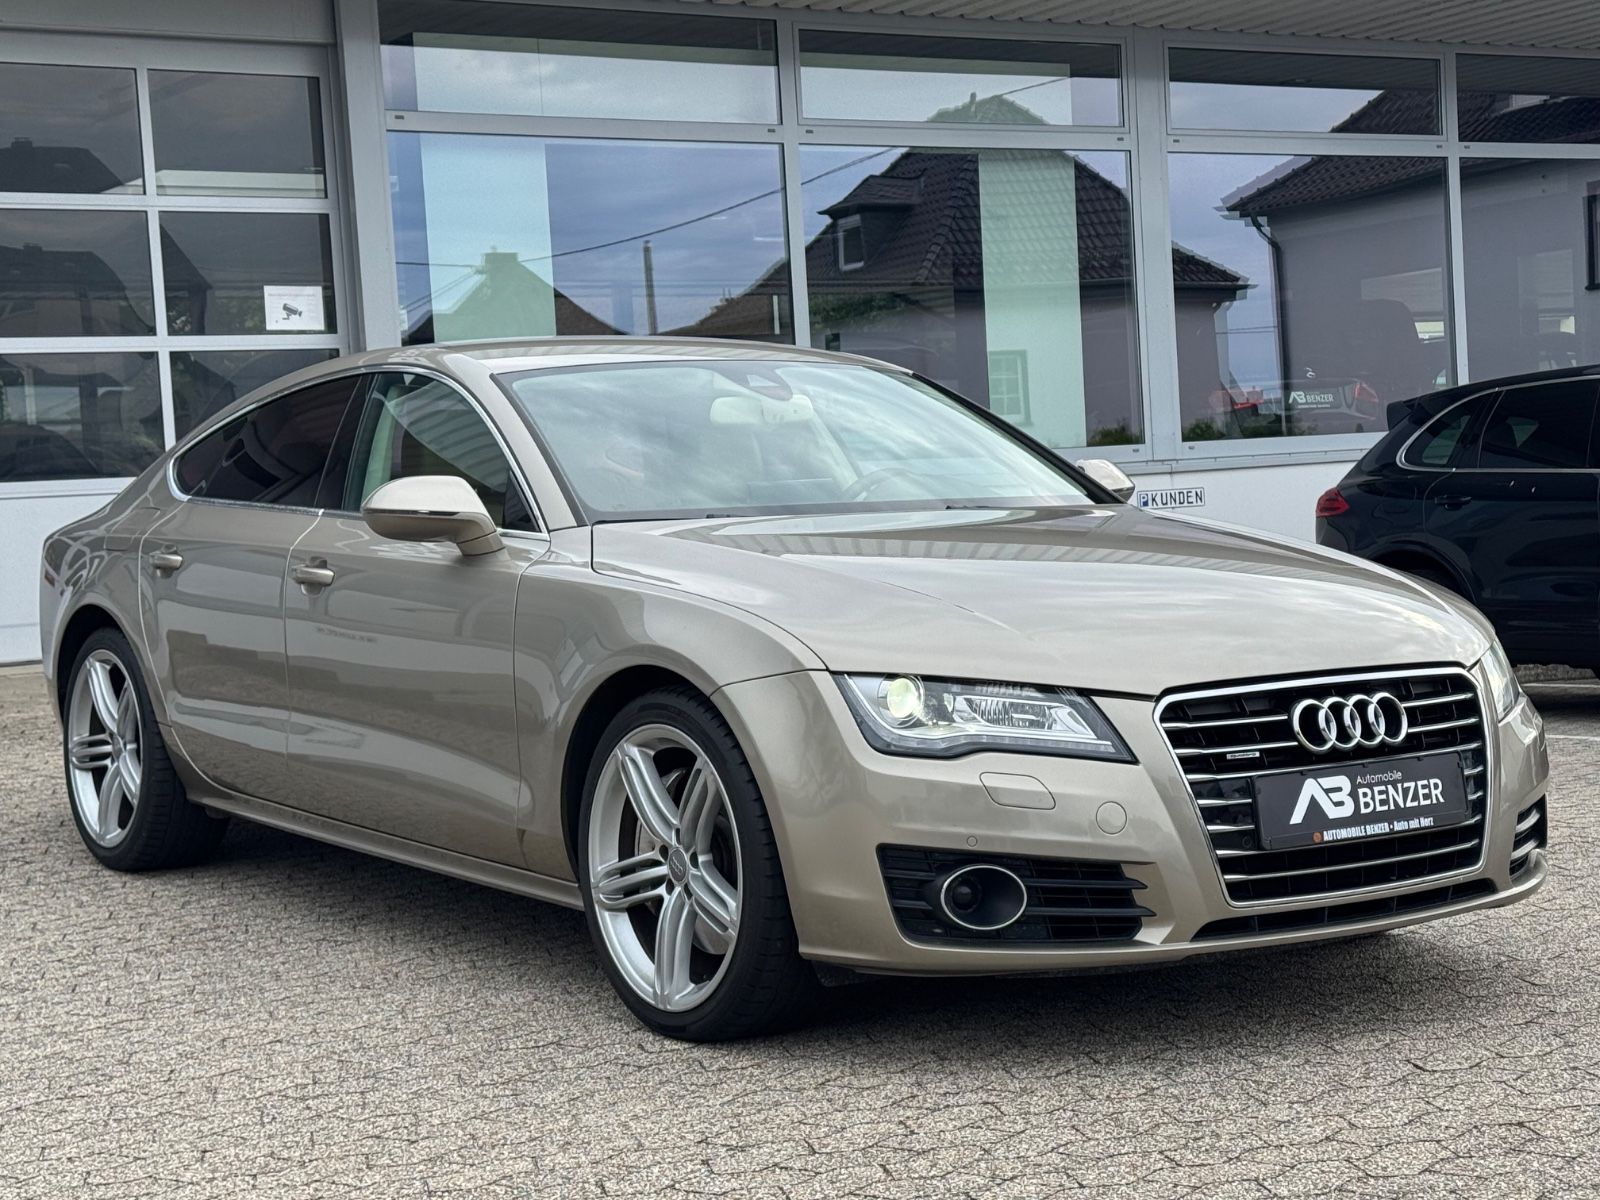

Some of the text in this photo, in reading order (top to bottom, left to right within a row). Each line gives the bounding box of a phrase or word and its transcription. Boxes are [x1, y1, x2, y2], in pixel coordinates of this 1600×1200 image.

[1306, 394, 1334, 403] BENZER
[1151, 490, 1203, 506] KUNDEN
[1356, 770, 1402, 785] Automobile
[1357, 778, 1445, 814] BENZER
[1323, 817, 1434, 841] AUTOMOBILE BENZER Auto mit Herz
